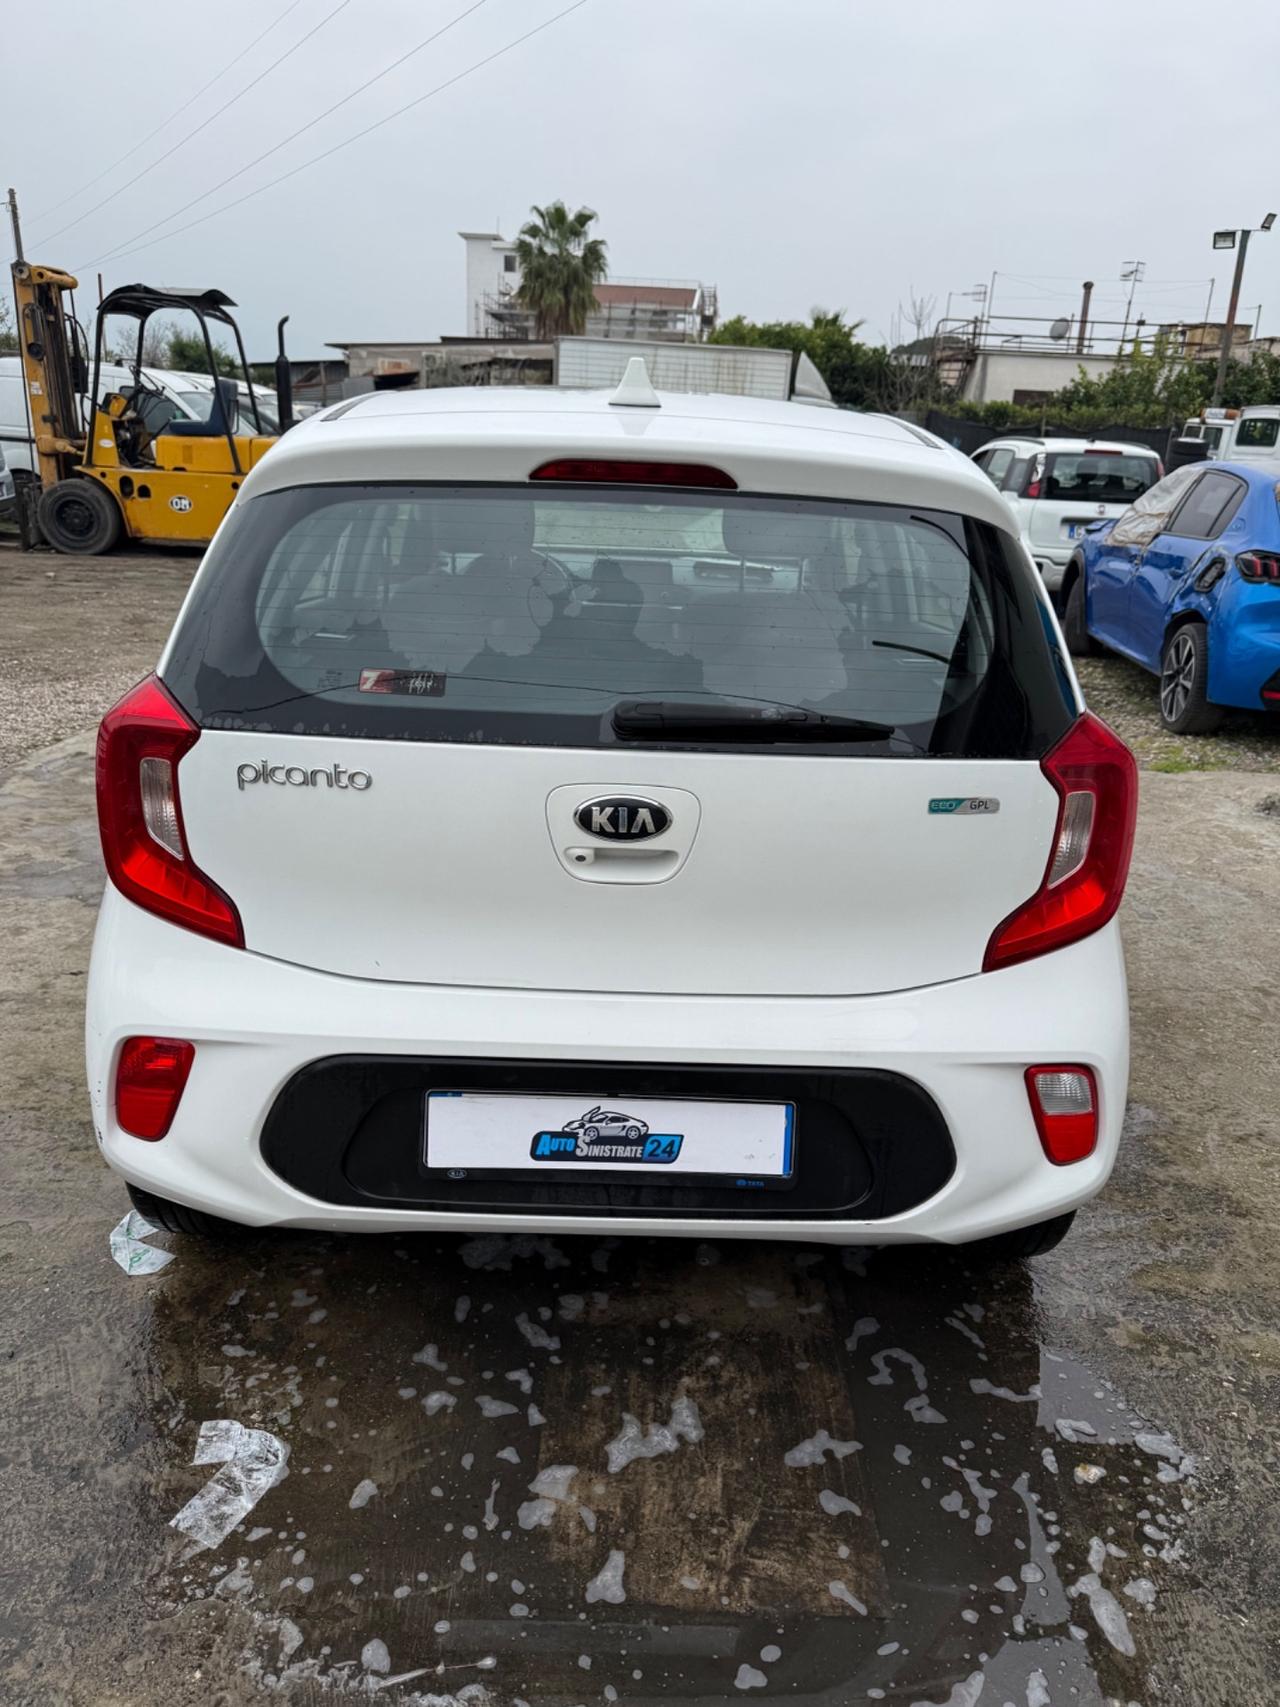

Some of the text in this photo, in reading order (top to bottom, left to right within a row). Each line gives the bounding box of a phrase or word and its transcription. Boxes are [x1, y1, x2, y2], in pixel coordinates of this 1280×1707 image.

[237, 759, 372, 791] picanto
[969, 800, 990, 810] GPL
[591, 806, 656, 833] KIA
[648, 1139, 676, 1157] 24
